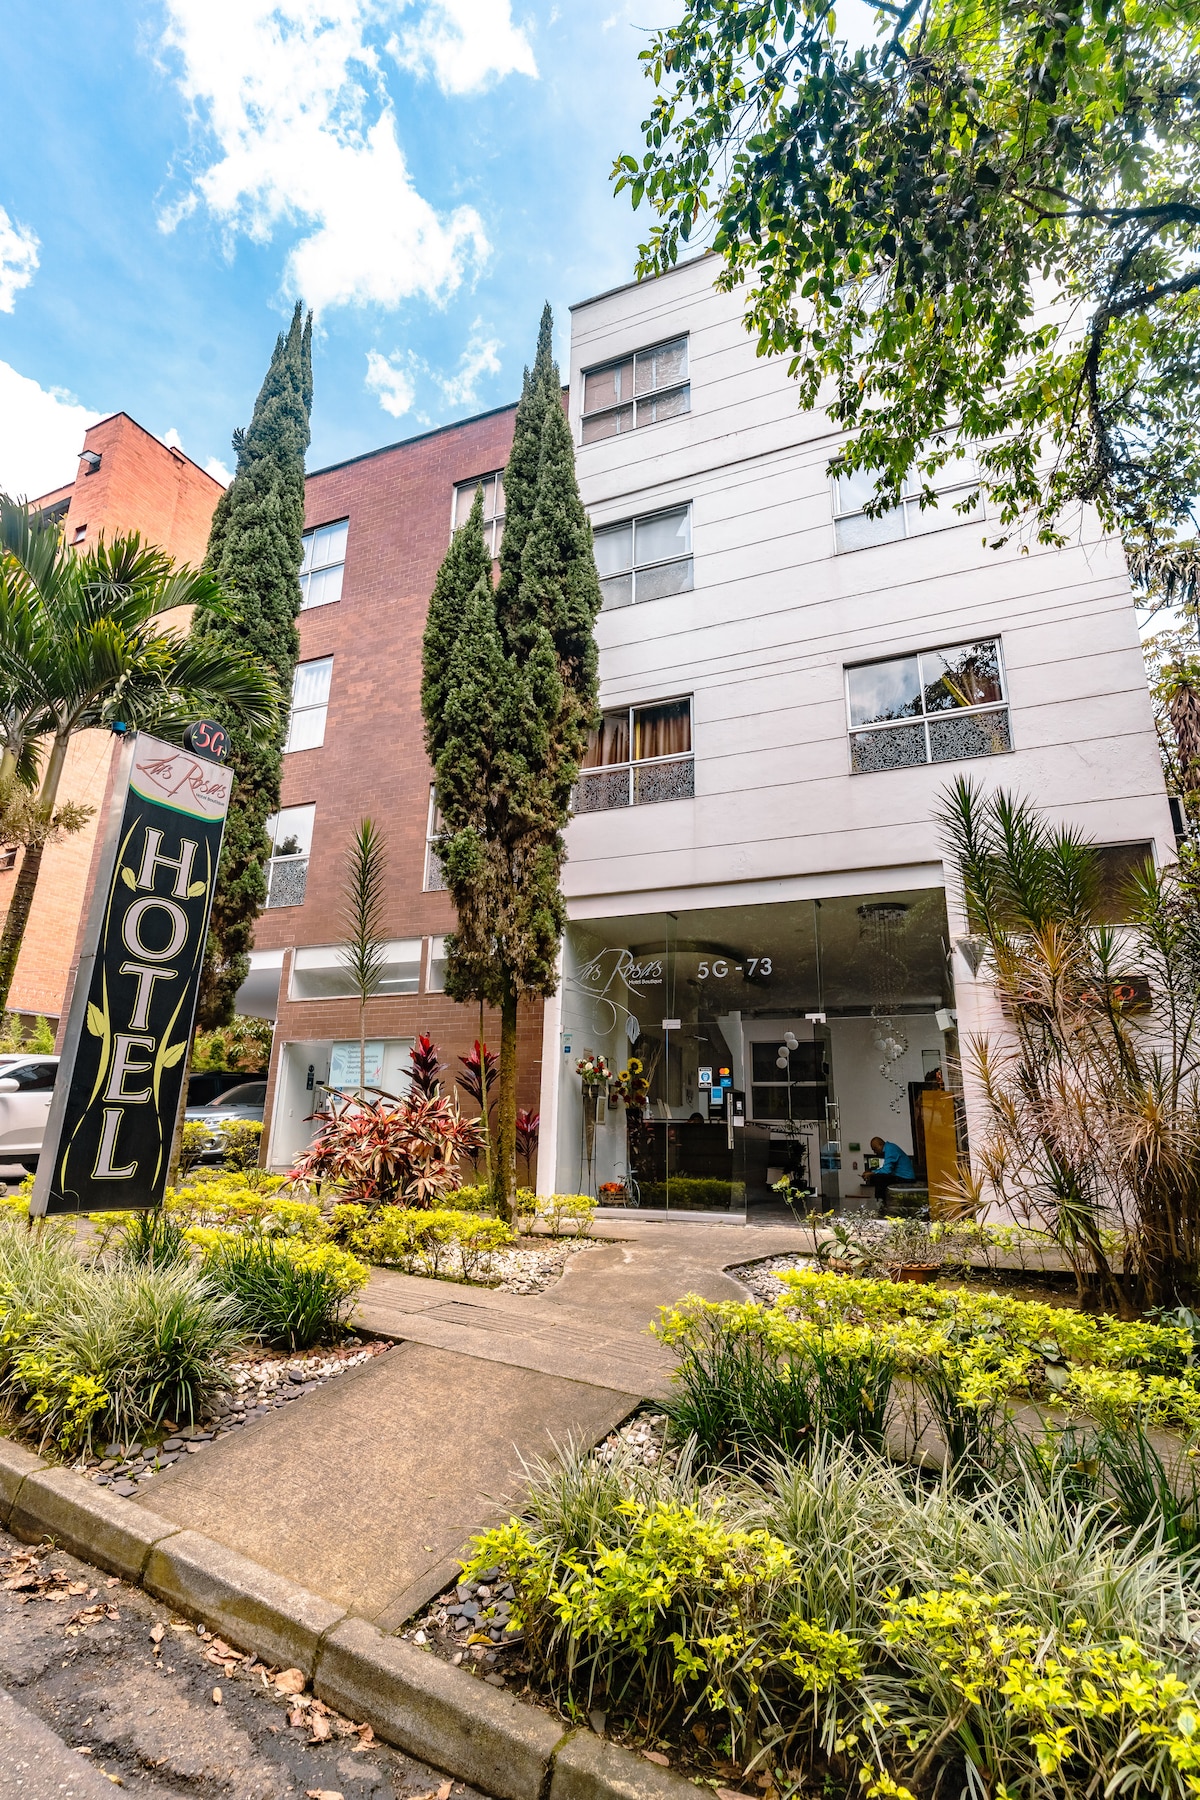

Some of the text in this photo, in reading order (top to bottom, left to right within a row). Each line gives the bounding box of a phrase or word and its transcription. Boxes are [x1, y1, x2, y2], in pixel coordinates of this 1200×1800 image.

[195, 723, 225, 757] 5G
[167, 756, 227, 811] Rosas
[91, 826, 199, 1180] HOTEL
[595, 948, 664, 1004] Rosas
